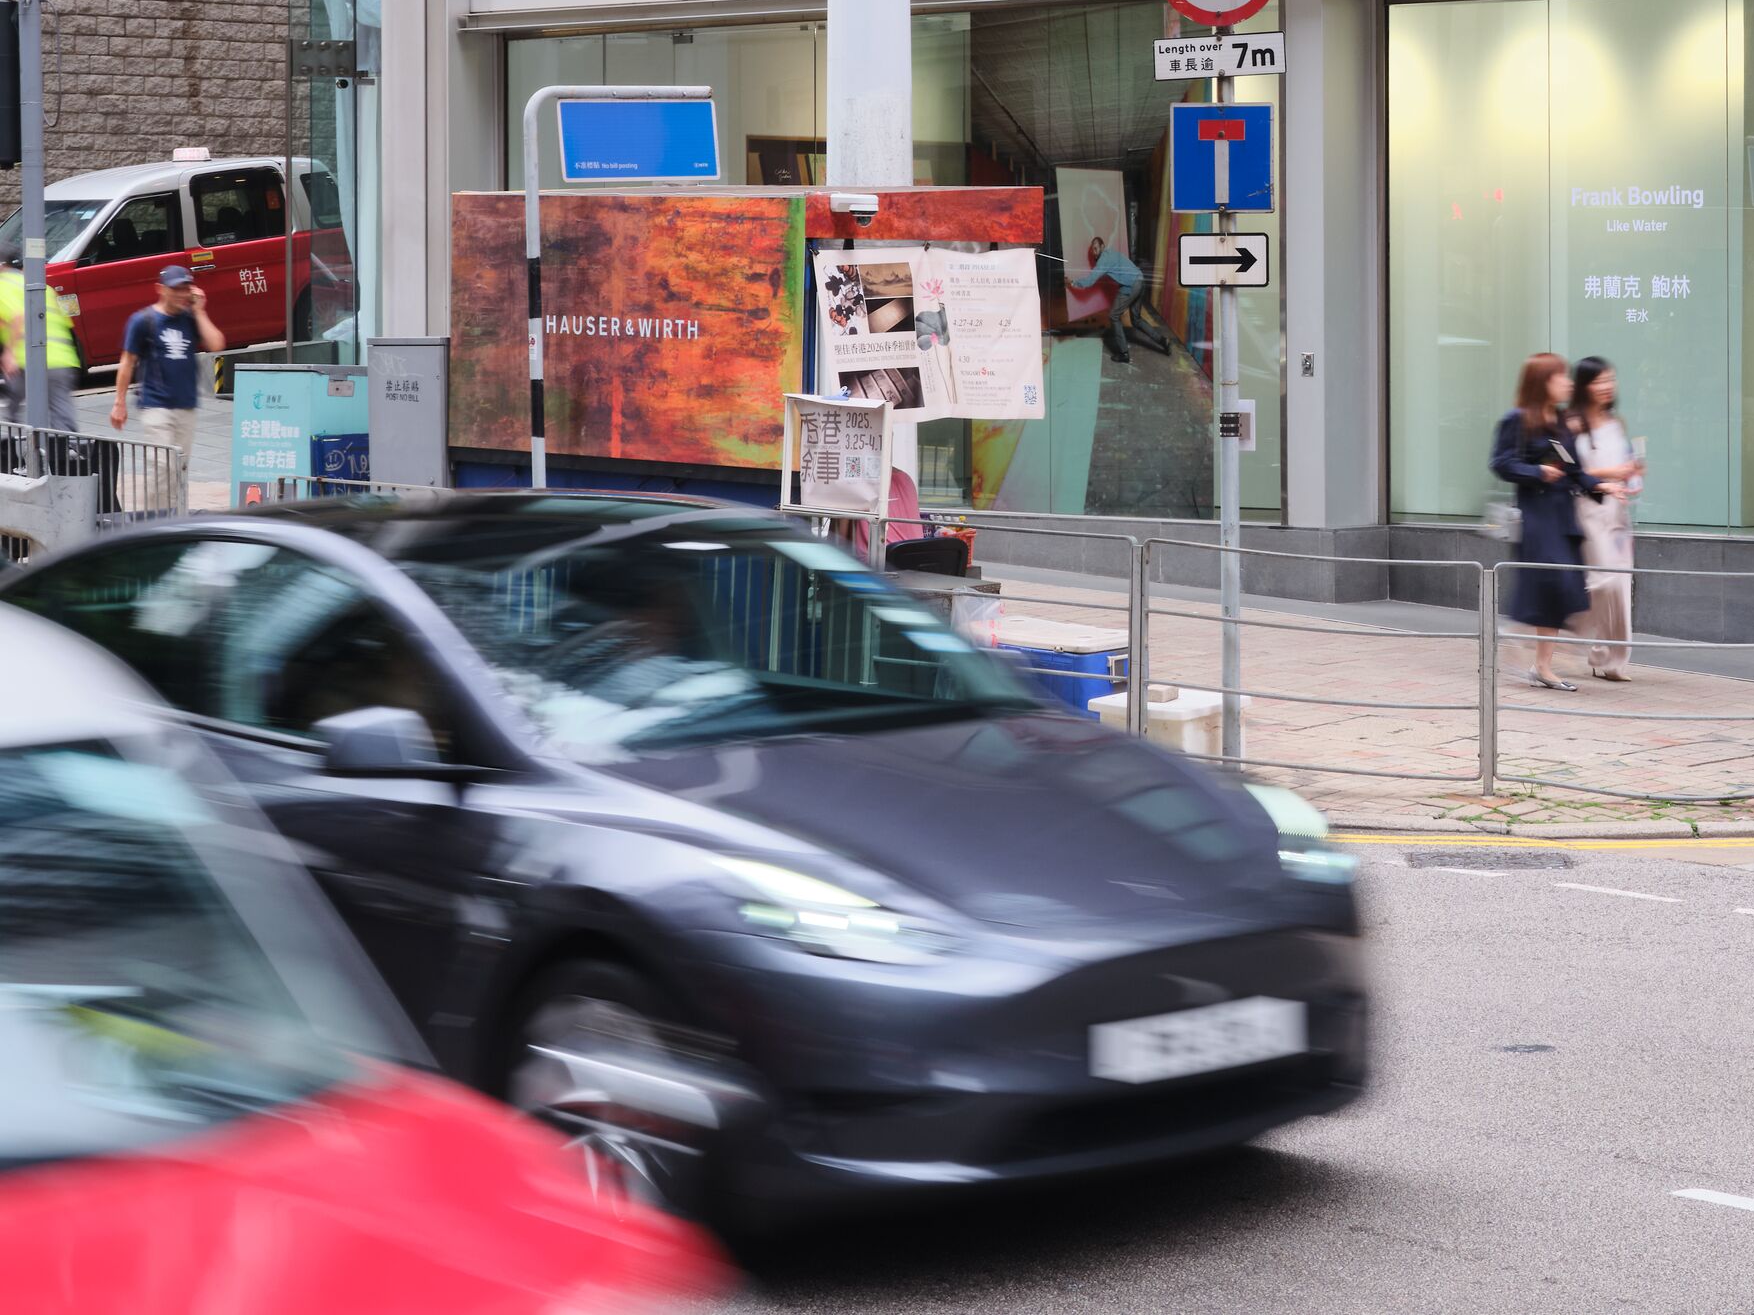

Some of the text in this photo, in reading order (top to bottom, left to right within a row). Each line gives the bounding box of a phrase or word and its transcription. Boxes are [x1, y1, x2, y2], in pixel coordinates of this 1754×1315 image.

[1159, 43, 1223, 55] Length over
[1231, 42, 1276, 69] 7m
[1169, 57, 1214, 73] 車長逾
[1571, 185, 1704, 209] Frank Bowling
[1606, 220, 1668, 232] Like Water
[239, 267, 265, 281] 的士
[241, 280, 268, 295] TAXI
[1584, 275, 1691, 299] 弗蘭克 鮑林
[1625, 308, 1649, 323] 若水
[385, 393, 419, 402] POST NO BILL
